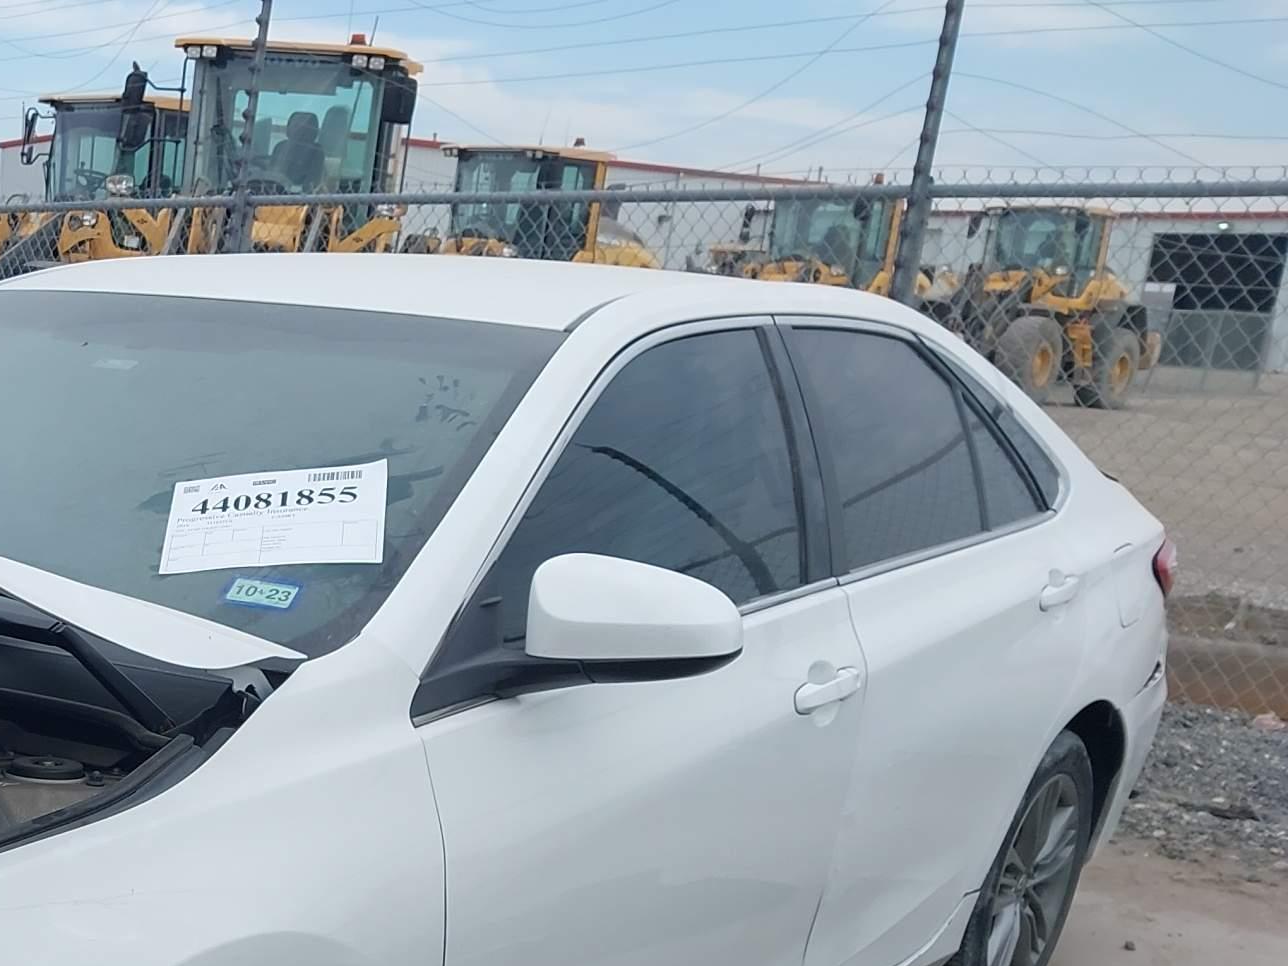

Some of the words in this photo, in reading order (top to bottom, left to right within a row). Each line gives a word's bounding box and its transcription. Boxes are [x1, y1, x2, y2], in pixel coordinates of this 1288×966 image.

[192, 486, 358, 515] 44081855
[235, 583, 258, 598] 10
[265, 588, 292, 603] 23
